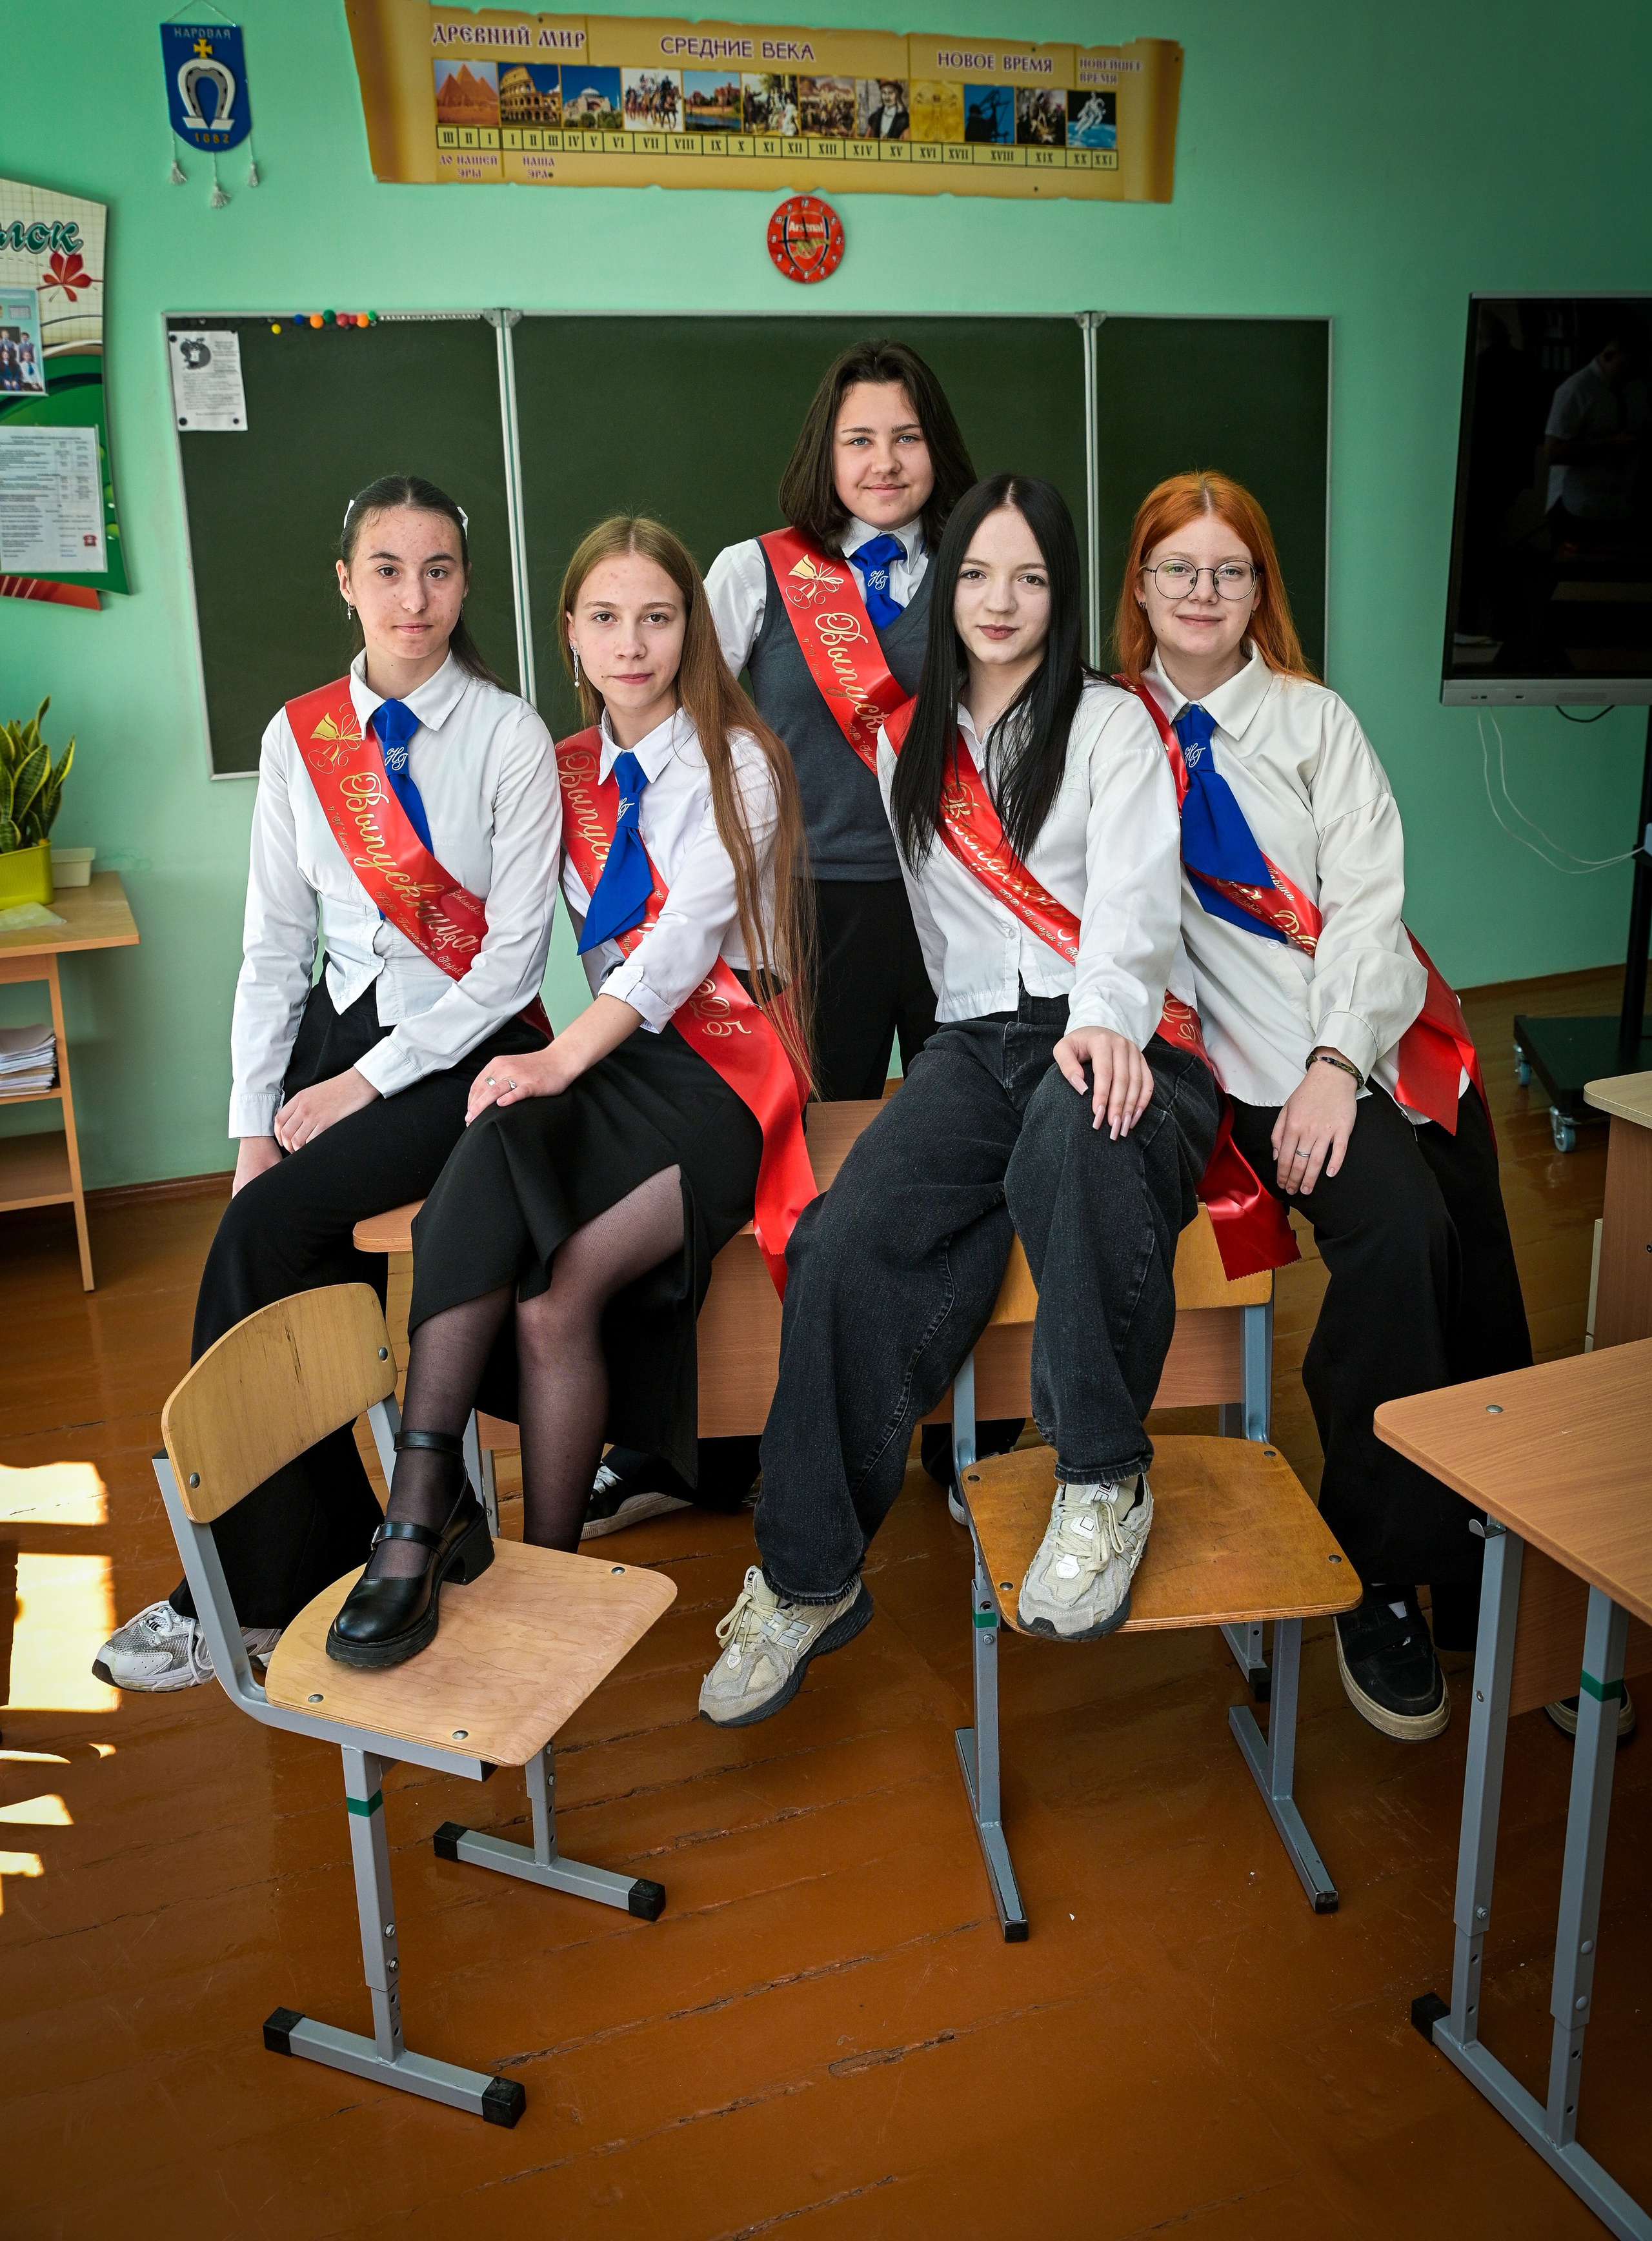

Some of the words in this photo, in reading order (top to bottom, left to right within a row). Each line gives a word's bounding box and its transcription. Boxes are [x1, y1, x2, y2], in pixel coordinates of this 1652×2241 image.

[433, 24, 531, 46] ДРЕВНИЙ
[538, 30, 586, 48] МИР
[660, 36, 753, 60] СРЕДНИЕ
[762, 41, 815, 61] ВЕКА
[938, 51, 995, 70] НОВОЕ
[1003, 55, 1053, 74] ВРЕМЯ
[1080, 57, 1142, 72] НОВЕЙШЕЕ
[1080, 72, 1117, 85] ВРЕМЯ
[443, 131, 454, 143] III
[465, 132, 472, 144] II
[530, 134, 537, 146] II
[549, 134, 559, 147] III
[568, 135, 579, 147] IV
[590, 136, 598, 148] V
[612, 136, 624, 148] VI
[643, 137, 659, 149] VII
[674, 138, 694, 150] VIII
[711, 139, 721, 152] IX
[738, 140, 745, 152] X
[763, 141, 774, 153] XI
[788, 142, 802, 154] XII
[818, 143, 837, 155] XIII
[853, 144, 872, 156] XIV
[890, 145, 903, 157] XV
[920, 147, 936, 159] XVI
[949, 148, 968, 161] XVII
[991, 149, 1014, 162] XVIII
[1036, 152, 1053, 164] XIX
[1074, 153, 1087, 165] XX
[1095, 154, 1113, 167] XXI
[456, 154, 498, 166] НАШЕЙ
[523, 156, 555, 167] НАША
[458, 168, 481, 178] ЭРЫ
[527, 168, 548, 179] ЭРА
[339, 772, 478, 953] Выпускница
